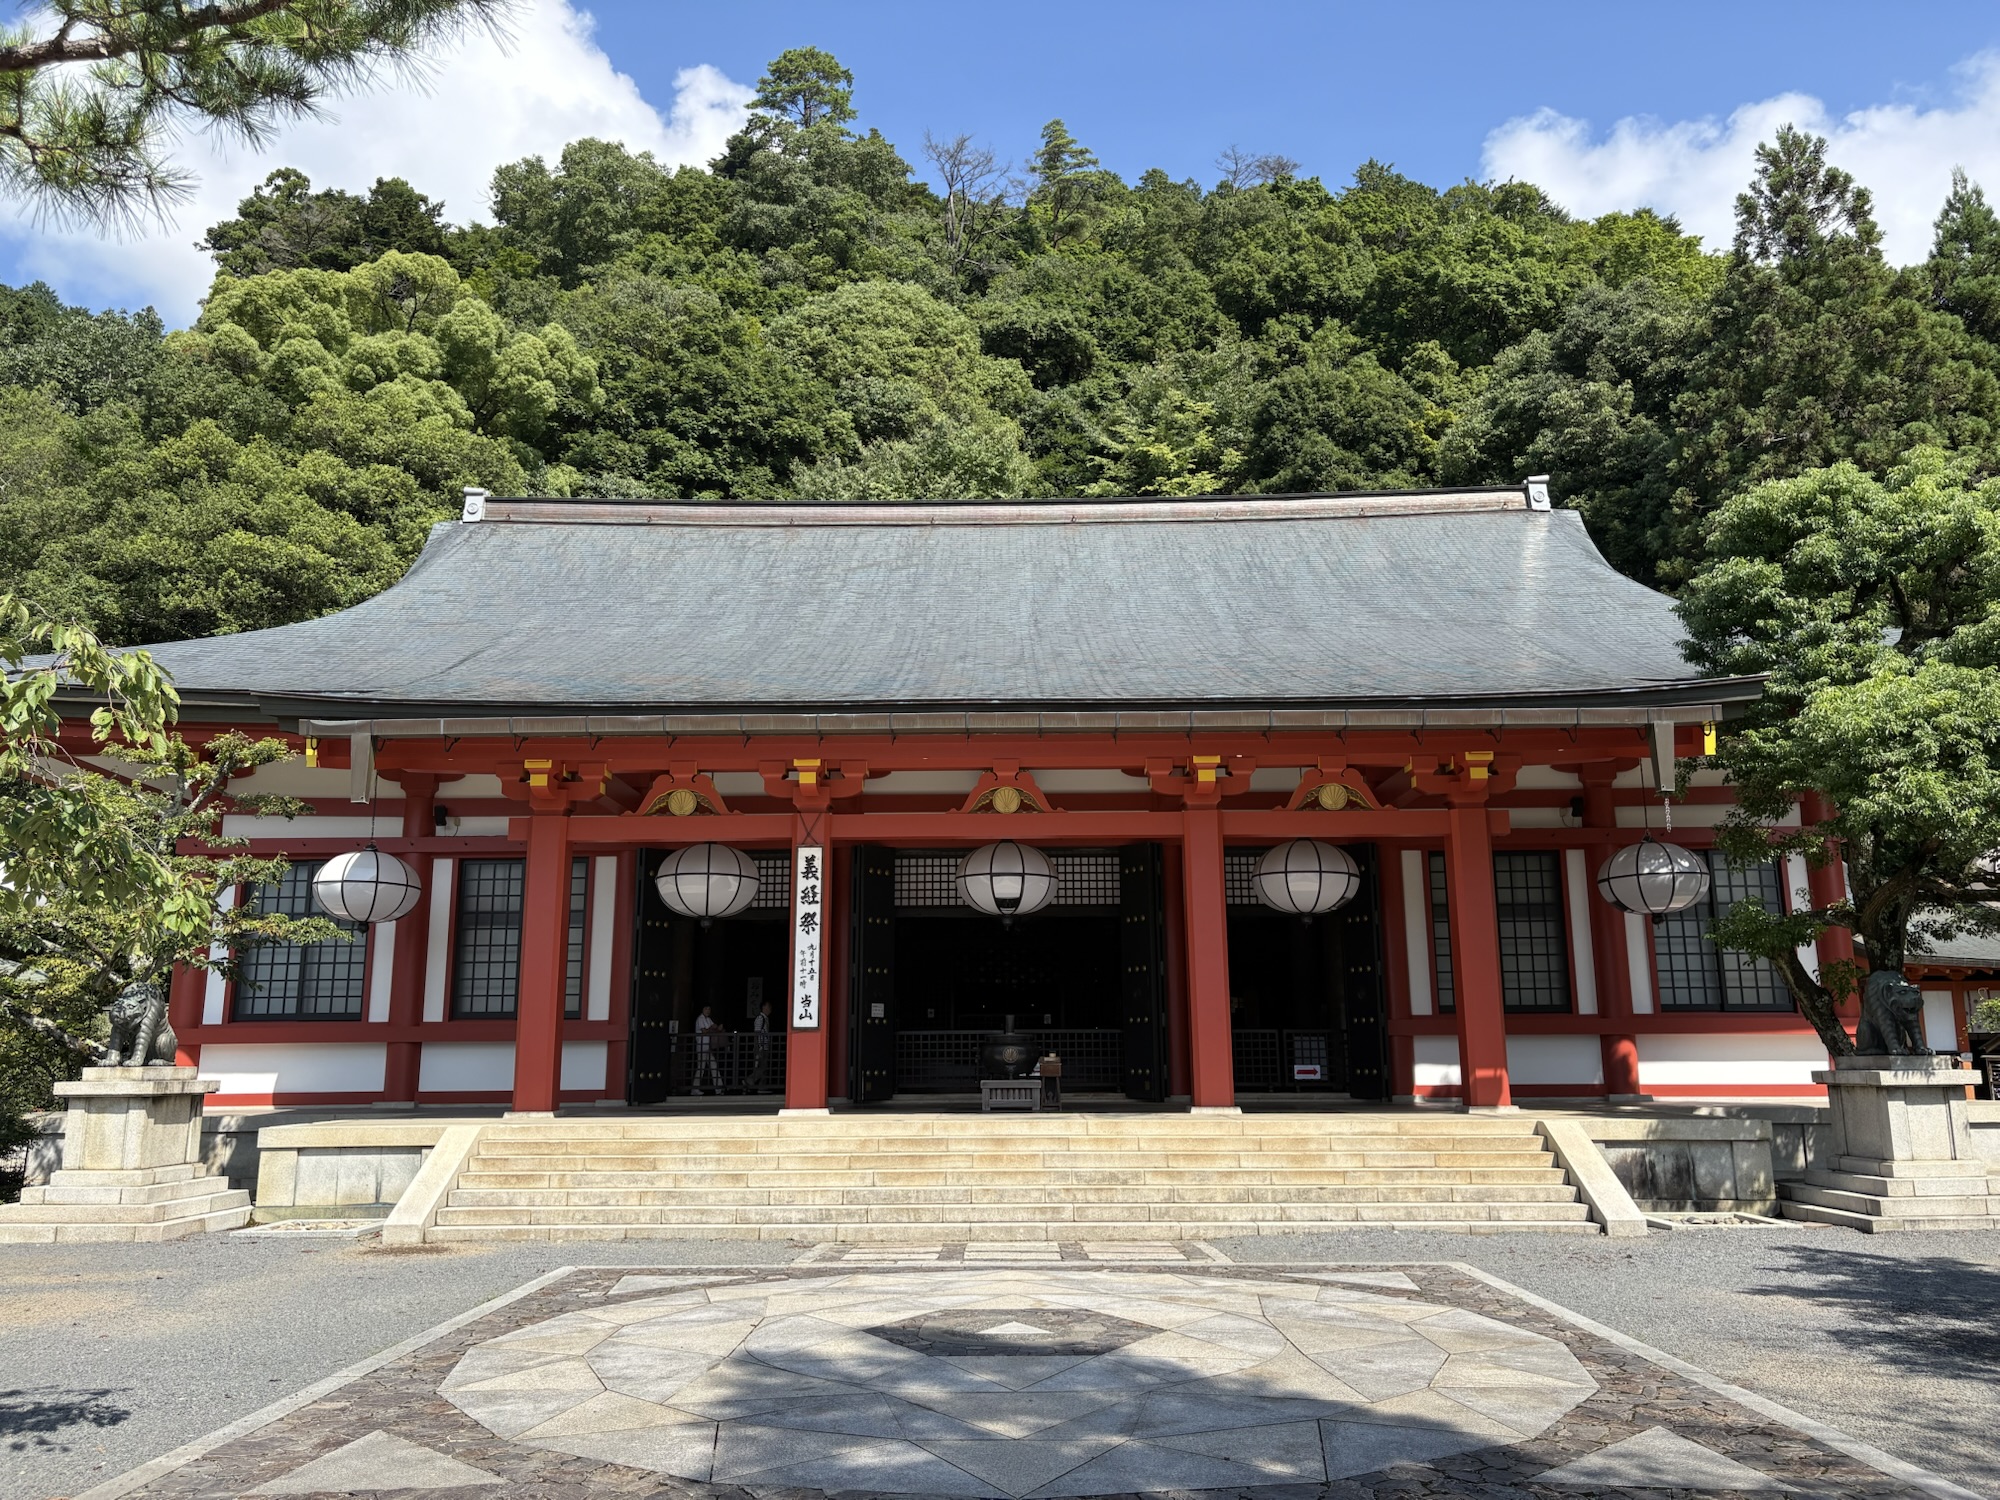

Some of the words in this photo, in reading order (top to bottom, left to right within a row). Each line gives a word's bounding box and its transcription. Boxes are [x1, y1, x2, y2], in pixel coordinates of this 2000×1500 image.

[799, 854, 820, 936] 義経祭
[799, 949, 807, 989] 午前十一時
[807, 943, 817, 981] 九月十五日
[799, 993, 813, 1020] 当山
